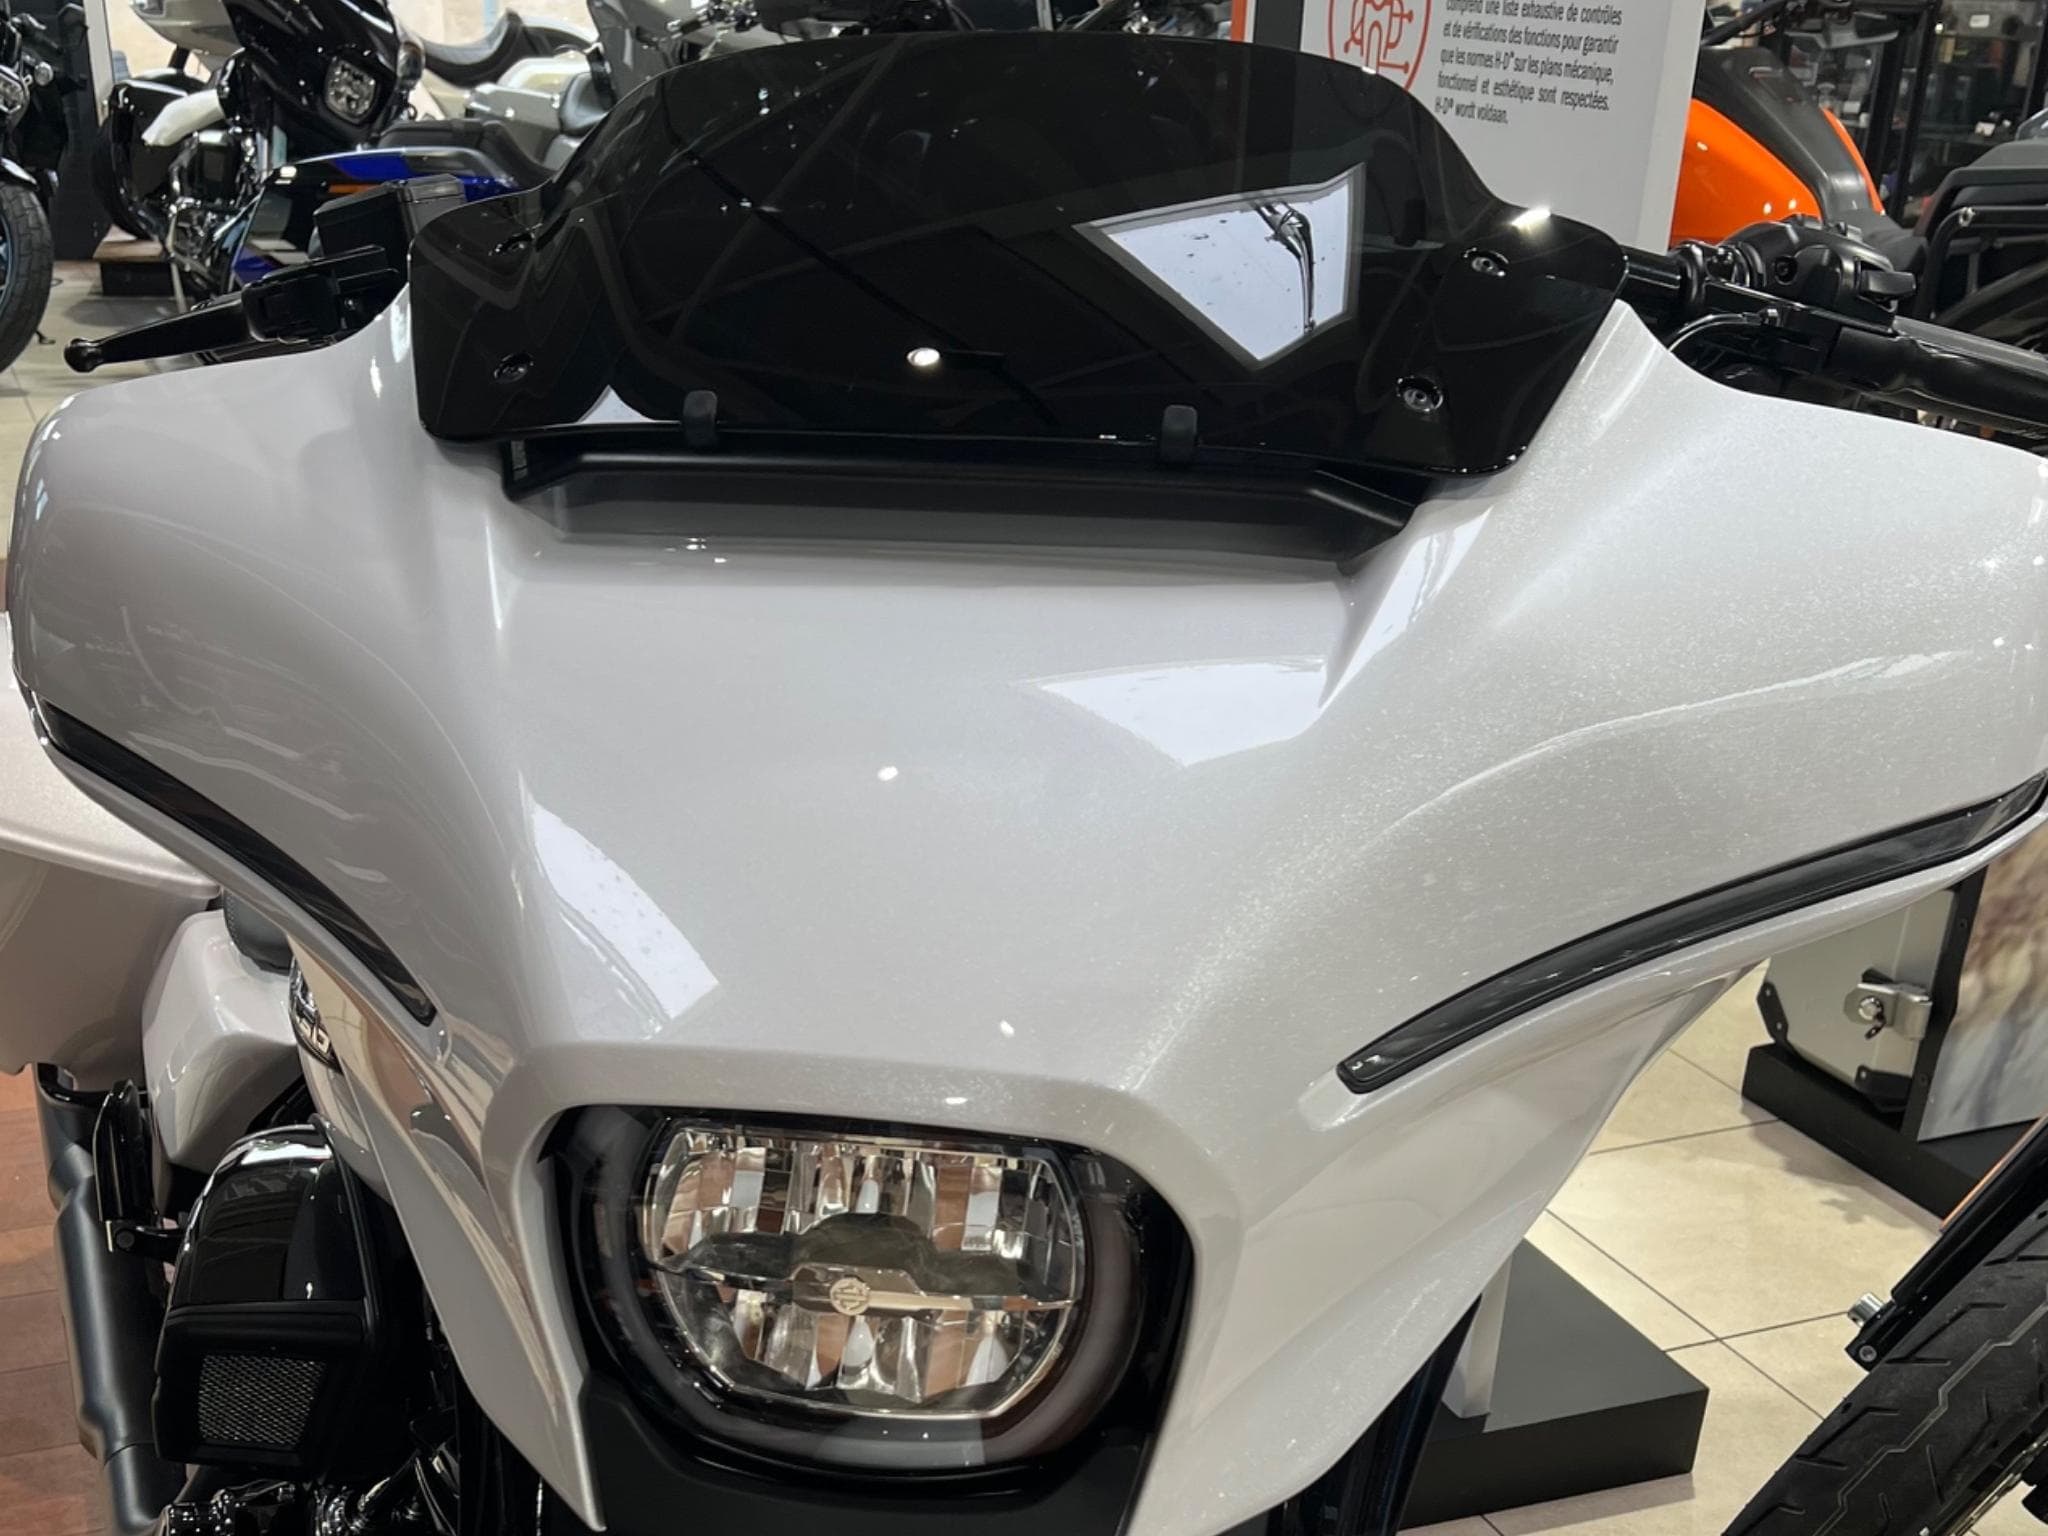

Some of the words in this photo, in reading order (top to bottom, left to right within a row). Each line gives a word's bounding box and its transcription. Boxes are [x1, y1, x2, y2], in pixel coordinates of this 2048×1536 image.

[1521, 1, 1564, 21] exhaustive
[1566, 3, 1579, 22] de
[1581, 5, 1623, 26] contrôles
[1443, 21, 1452, 37] et
[1452, 21, 1462, 39] de
[1463, 21, 1508, 43] vérifications
[1508, 24, 1523, 45] des
[1524, 26, 1561, 49] fonctions
[1561, 34, 1583, 53] pour
[1582, 34, 1619, 56] garantir
[1440, 49, 1455, 66] que
[1455, 47, 1466, 65] les
[1466, 51, 1494, 69] normes
[1513, 57, 1527, 72] sur
[1527, 55, 1540, 74] les
[1539, 57, 1563, 79] plans
[1563, 59, 1614, 85] mécanique,
[1437, 70, 1479, 92] fonctionnel
[1481, 77, 1490, 95] et
[1493, 79, 1535, 103] esthétique
[1538, 86, 1557, 104] sont
[1561, 90, 1610, 111] respectées.
